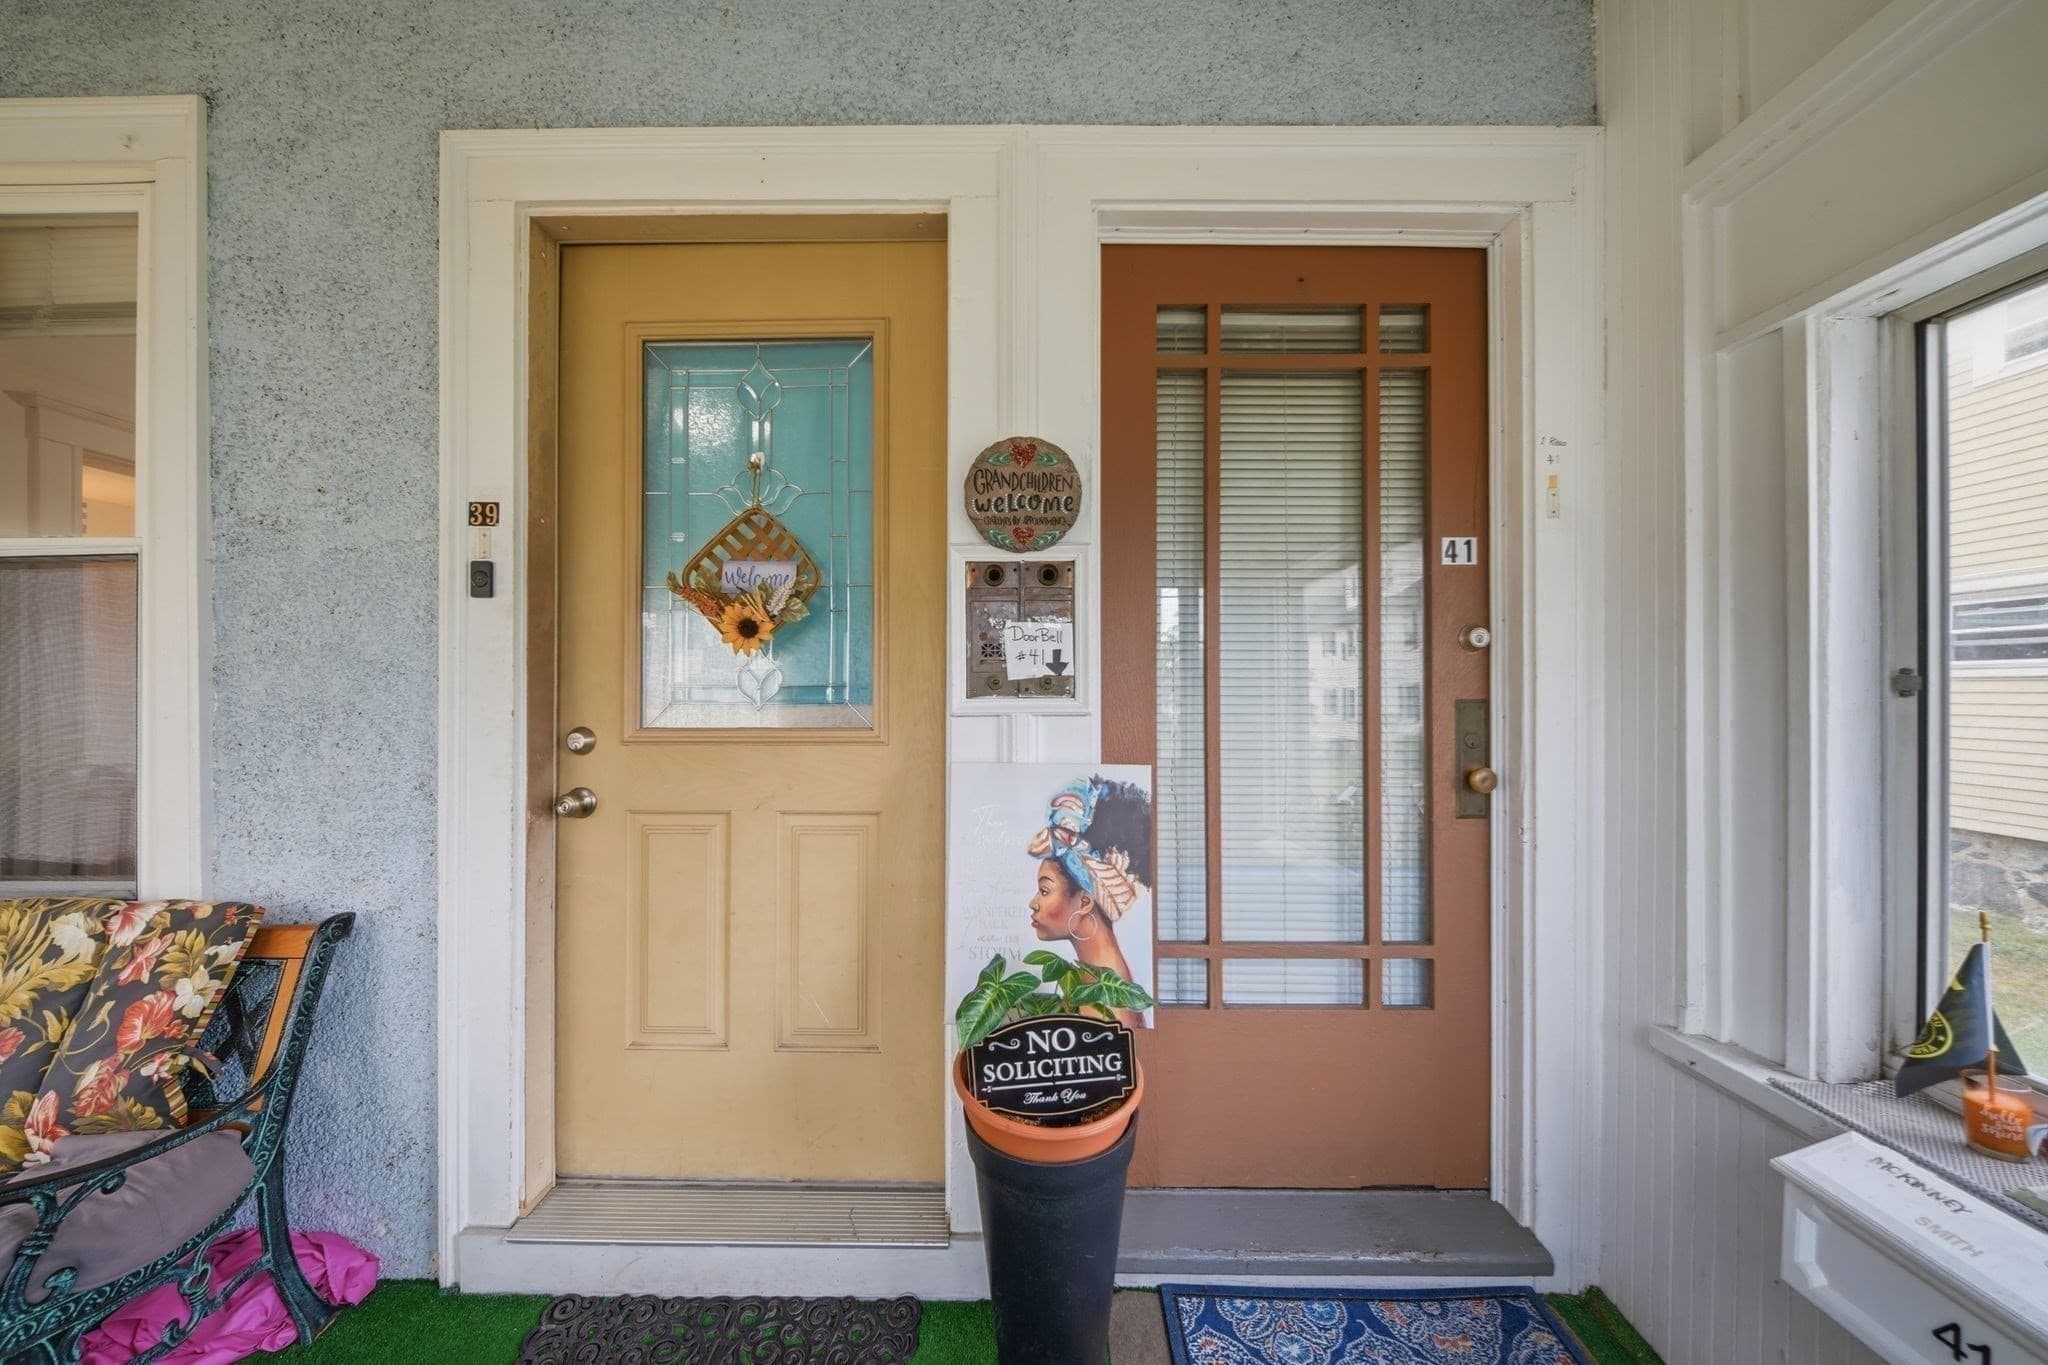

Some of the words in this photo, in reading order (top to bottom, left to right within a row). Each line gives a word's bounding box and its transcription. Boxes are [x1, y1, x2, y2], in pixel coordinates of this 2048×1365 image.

[973, 468, 1074, 495] GRANDCHILDREN
[470, 503, 498, 526] 39
[1444, 539, 1473, 564] 41
[1016, 648, 1045, 666] #41
[1026, 1027, 1076, 1055] NO
[983, 1053, 1122, 1083] SOLICITING
[1023, 1091, 1059, 1105] Thank
[1060, 1087, 1087, 1104] You
[1914, 1216, 1985, 1258] SMITH
